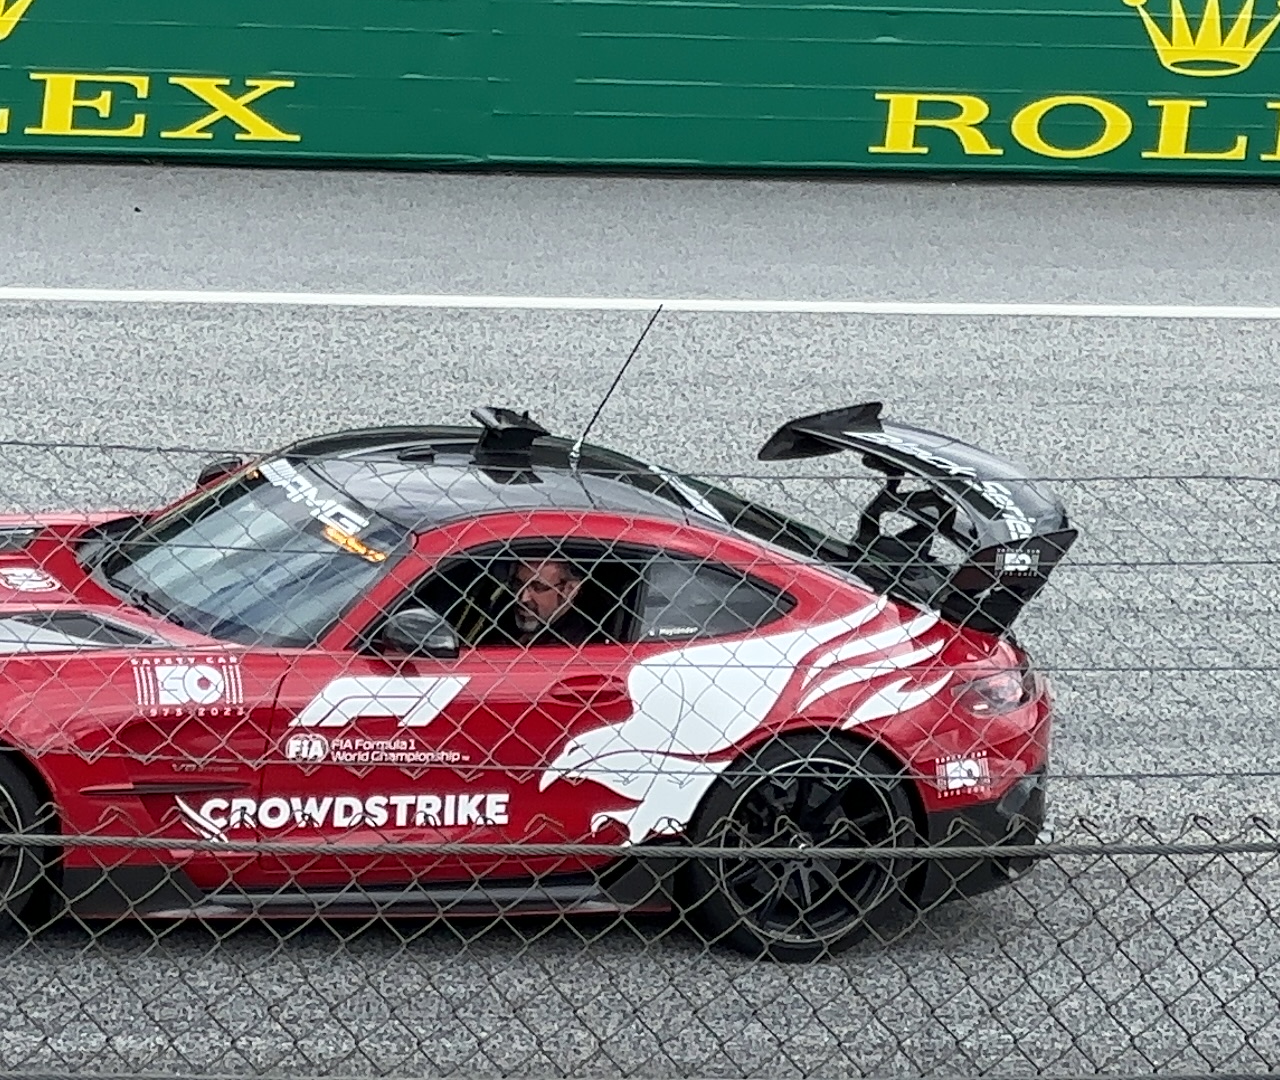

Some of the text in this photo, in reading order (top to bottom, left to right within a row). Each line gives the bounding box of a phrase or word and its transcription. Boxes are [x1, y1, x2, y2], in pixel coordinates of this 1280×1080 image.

[331, 738, 353, 751] FIA
[355, 738, 408, 751] Formula
[331, 751, 369, 763] World
[199, 793, 510, 829] CROWDSTRIKE
